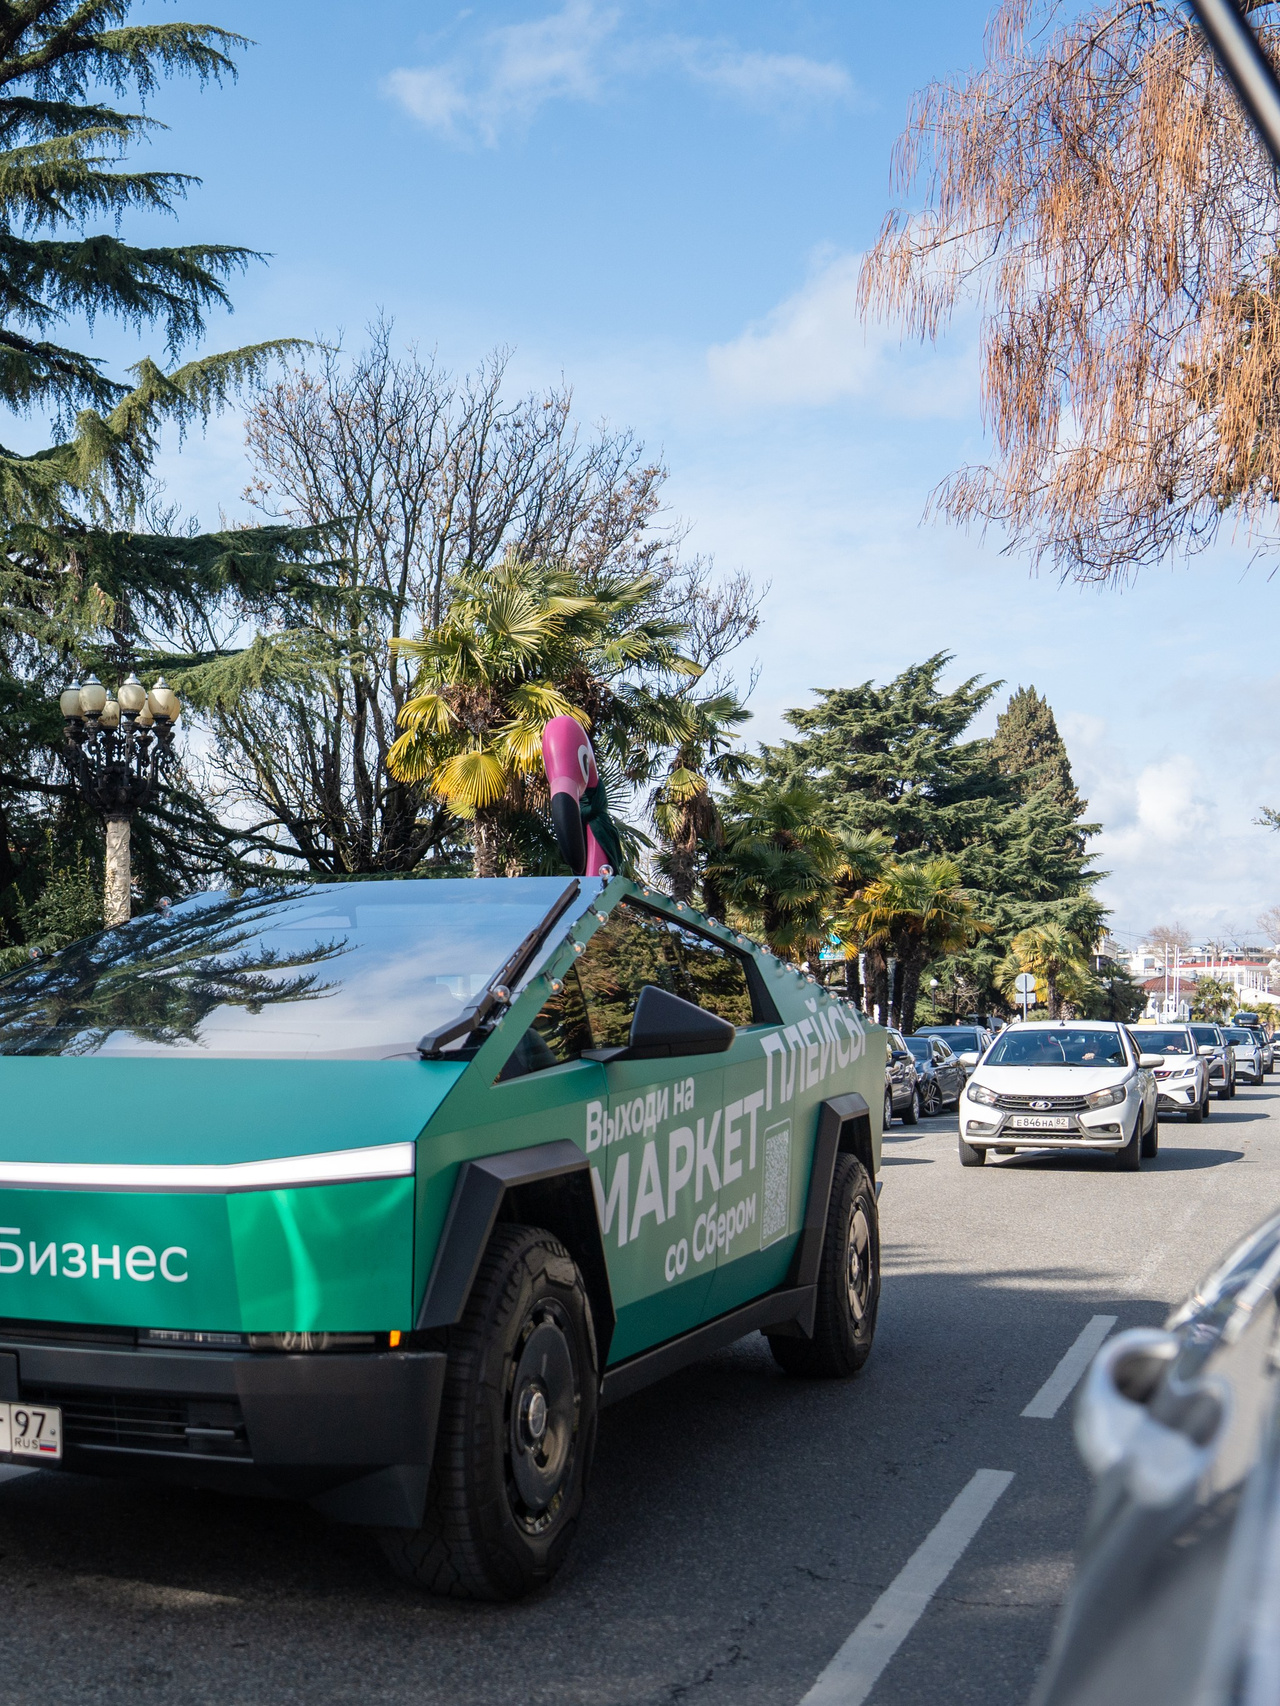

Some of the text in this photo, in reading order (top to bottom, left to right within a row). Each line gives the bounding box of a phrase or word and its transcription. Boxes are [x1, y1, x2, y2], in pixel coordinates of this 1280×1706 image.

[586, 1077, 695, 1153] Выходи на
[664, 1192, 756, 1282] со Сбером
[14, 1409, 46, 1439] 97
[14, 1437, 38, 1449] RUS
